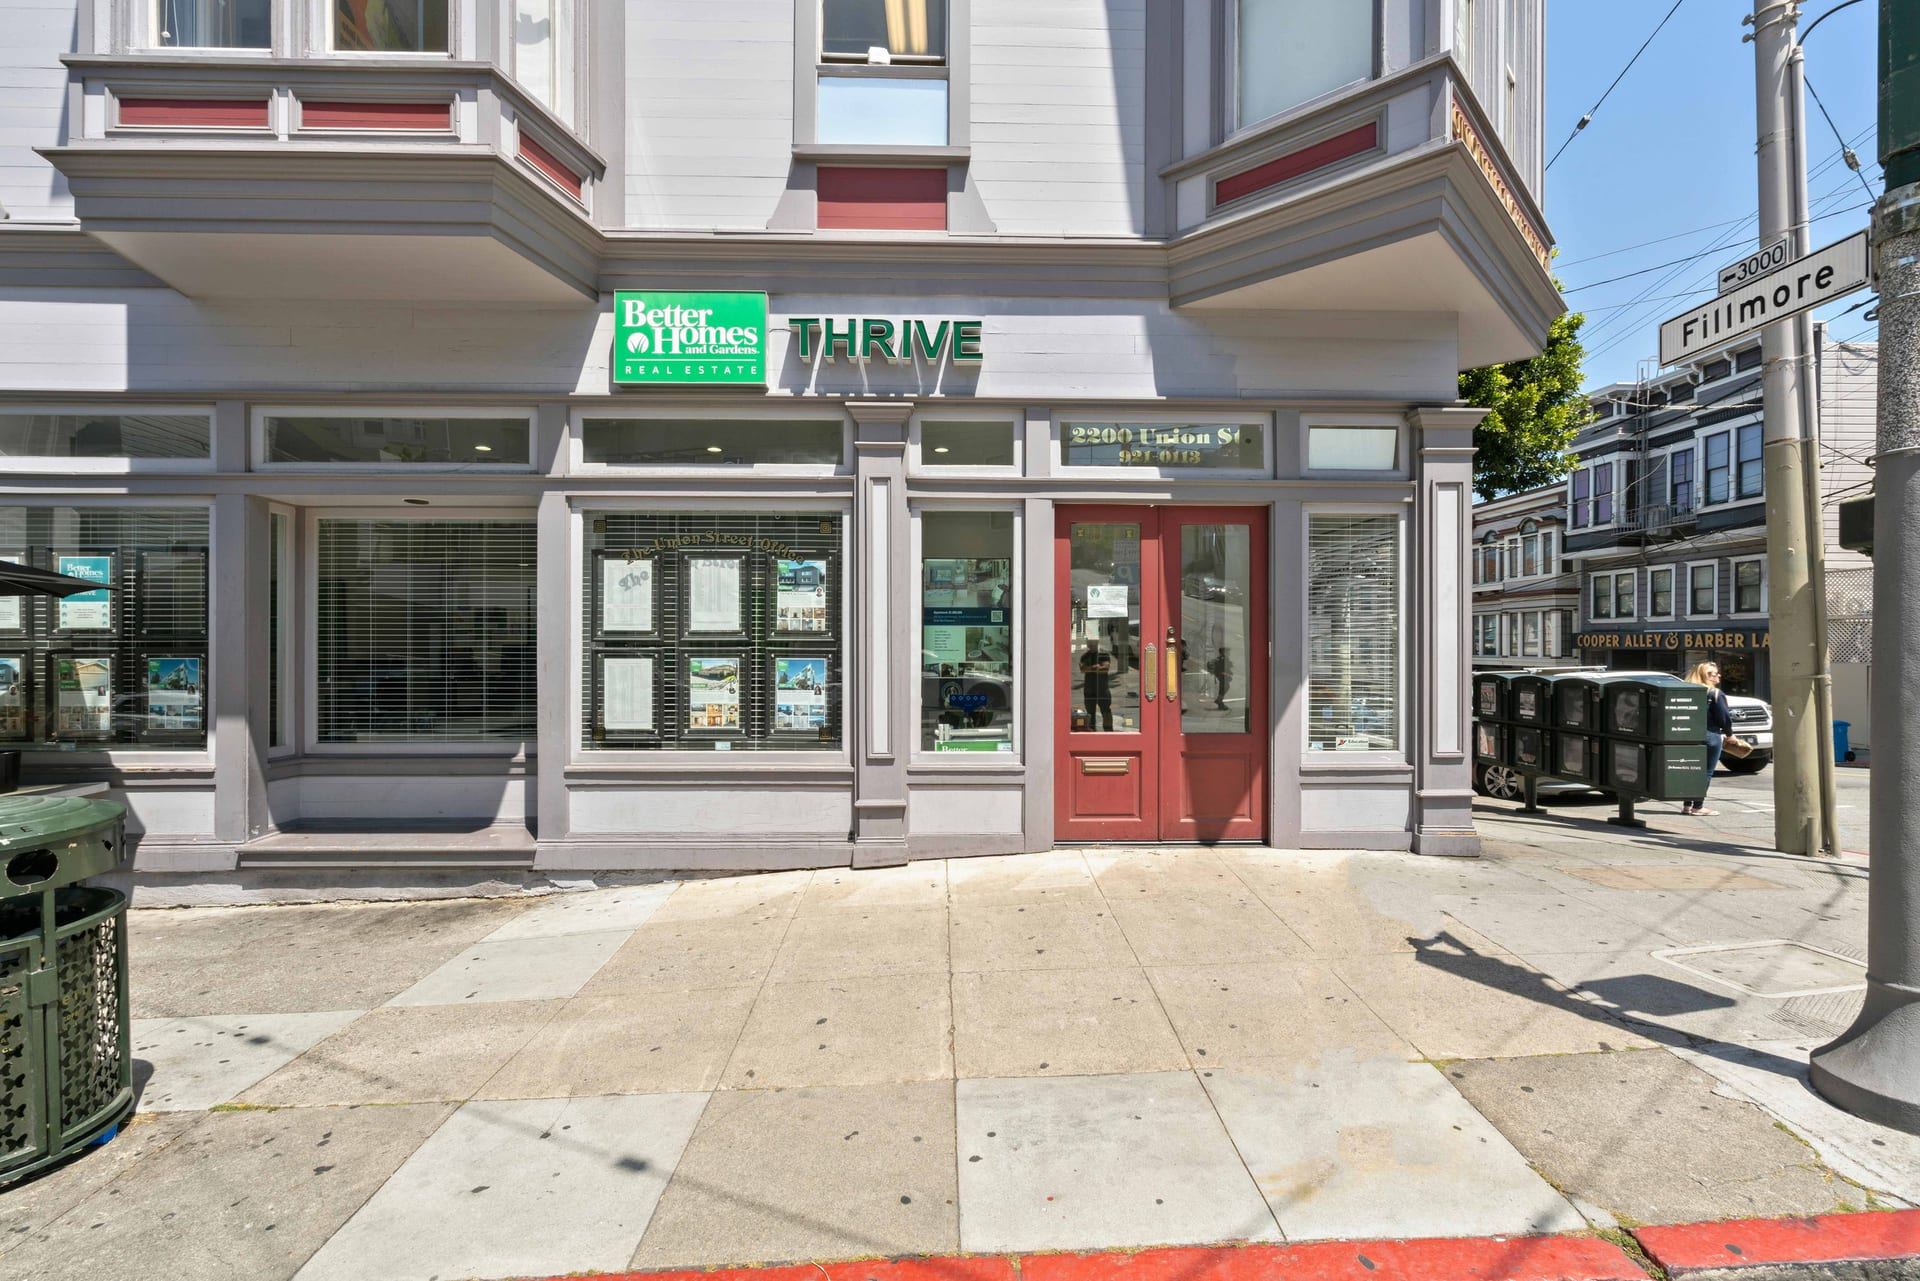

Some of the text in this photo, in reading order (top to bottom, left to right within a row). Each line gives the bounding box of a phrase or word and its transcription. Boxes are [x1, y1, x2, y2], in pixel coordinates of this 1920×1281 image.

[1737, 245, 1784, 281] 3000
[622, 299, 713, 328] Better
[1683, 264, 1834, 348] Fillmore
[651, 326, 758, 355] Homes
[685, 344, 757, 355] and Gardens
[789, 318, 984, 365] THRIVE
[625, 365, 757, 375] REAL ESTATE
[1072, 427, 1133, 444] 2200
[1139, 427, 1211, 445] Union
[1118, 450, 1201, 464] 921-0113
[620, 545, 650, 565] The
[654, 533, 701, 550] Union
[704, 530, 753, 547] Street
[759, 538, 805, 566] Office
[1577, 634, 1619, 648] COOPER
[1624, 634, 1662, 648] ALLEY
[1665, 631, 1679, 650] &
[1684, 633, 1745, 648] BARBER
